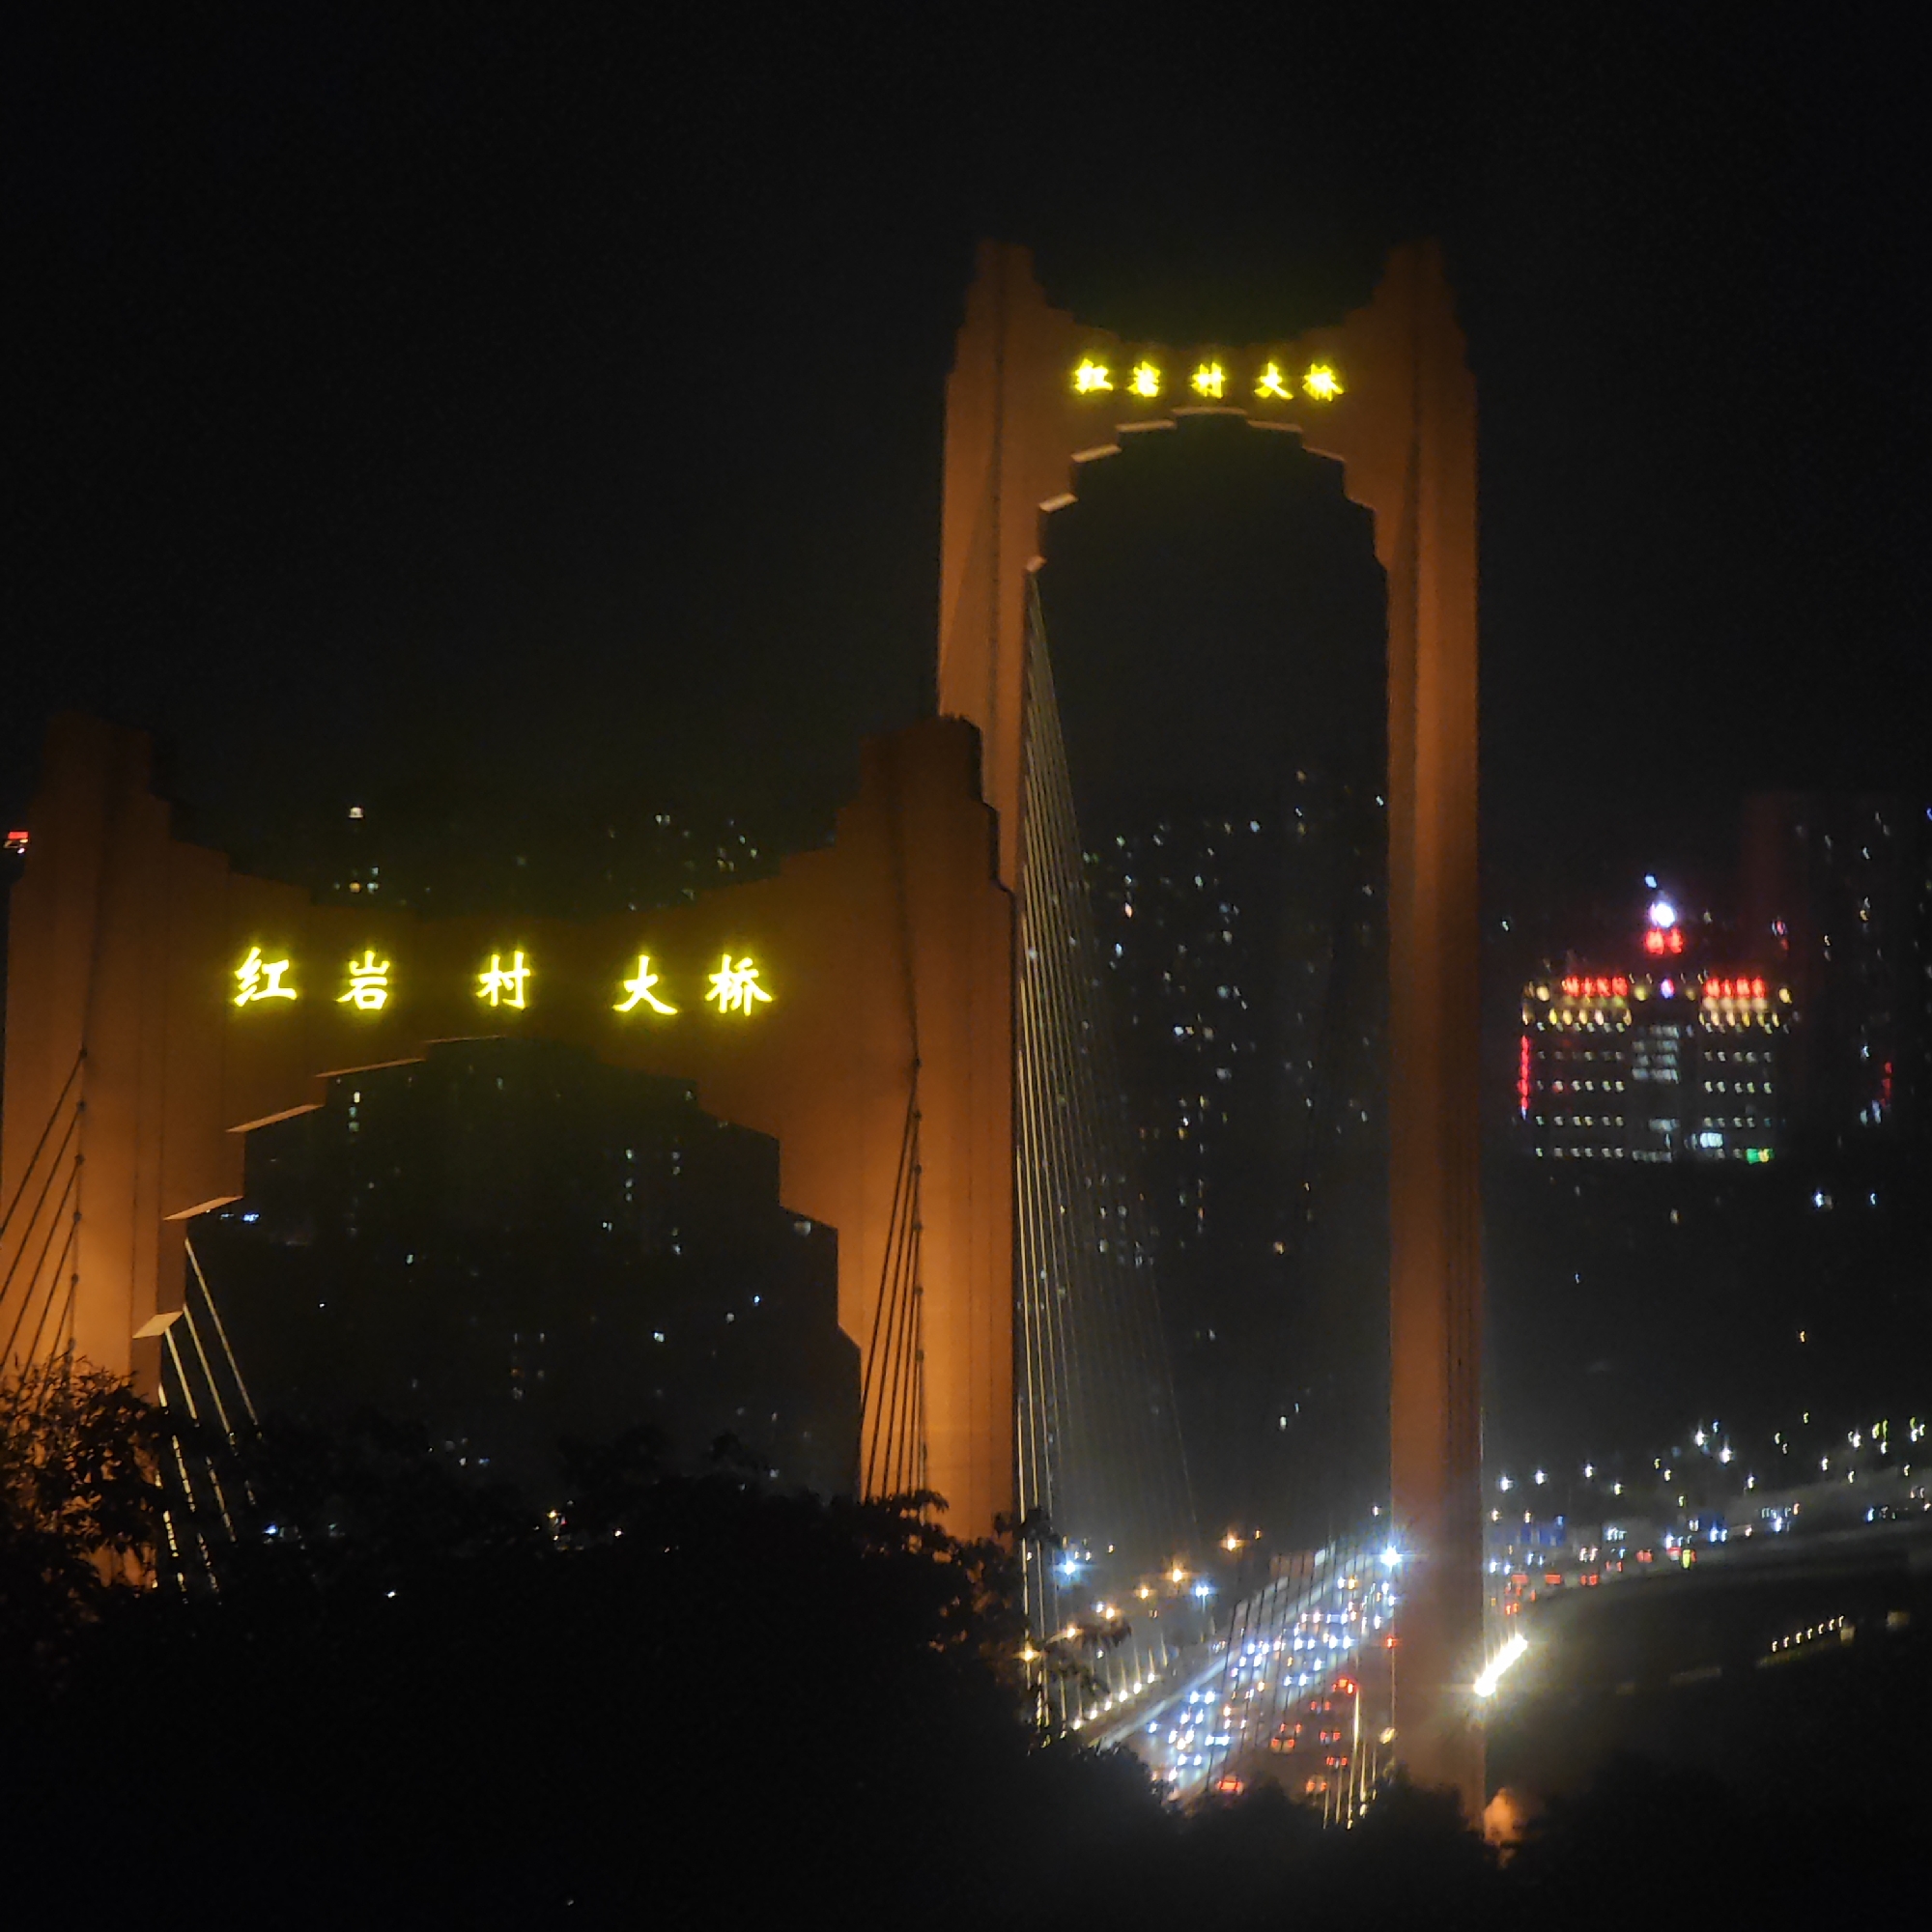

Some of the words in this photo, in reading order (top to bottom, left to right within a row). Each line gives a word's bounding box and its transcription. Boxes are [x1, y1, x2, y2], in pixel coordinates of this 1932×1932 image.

[1073, 358, 1344, 402] 红岩村大桥
[233, 946, 774, 1016] 红岩村大桥
